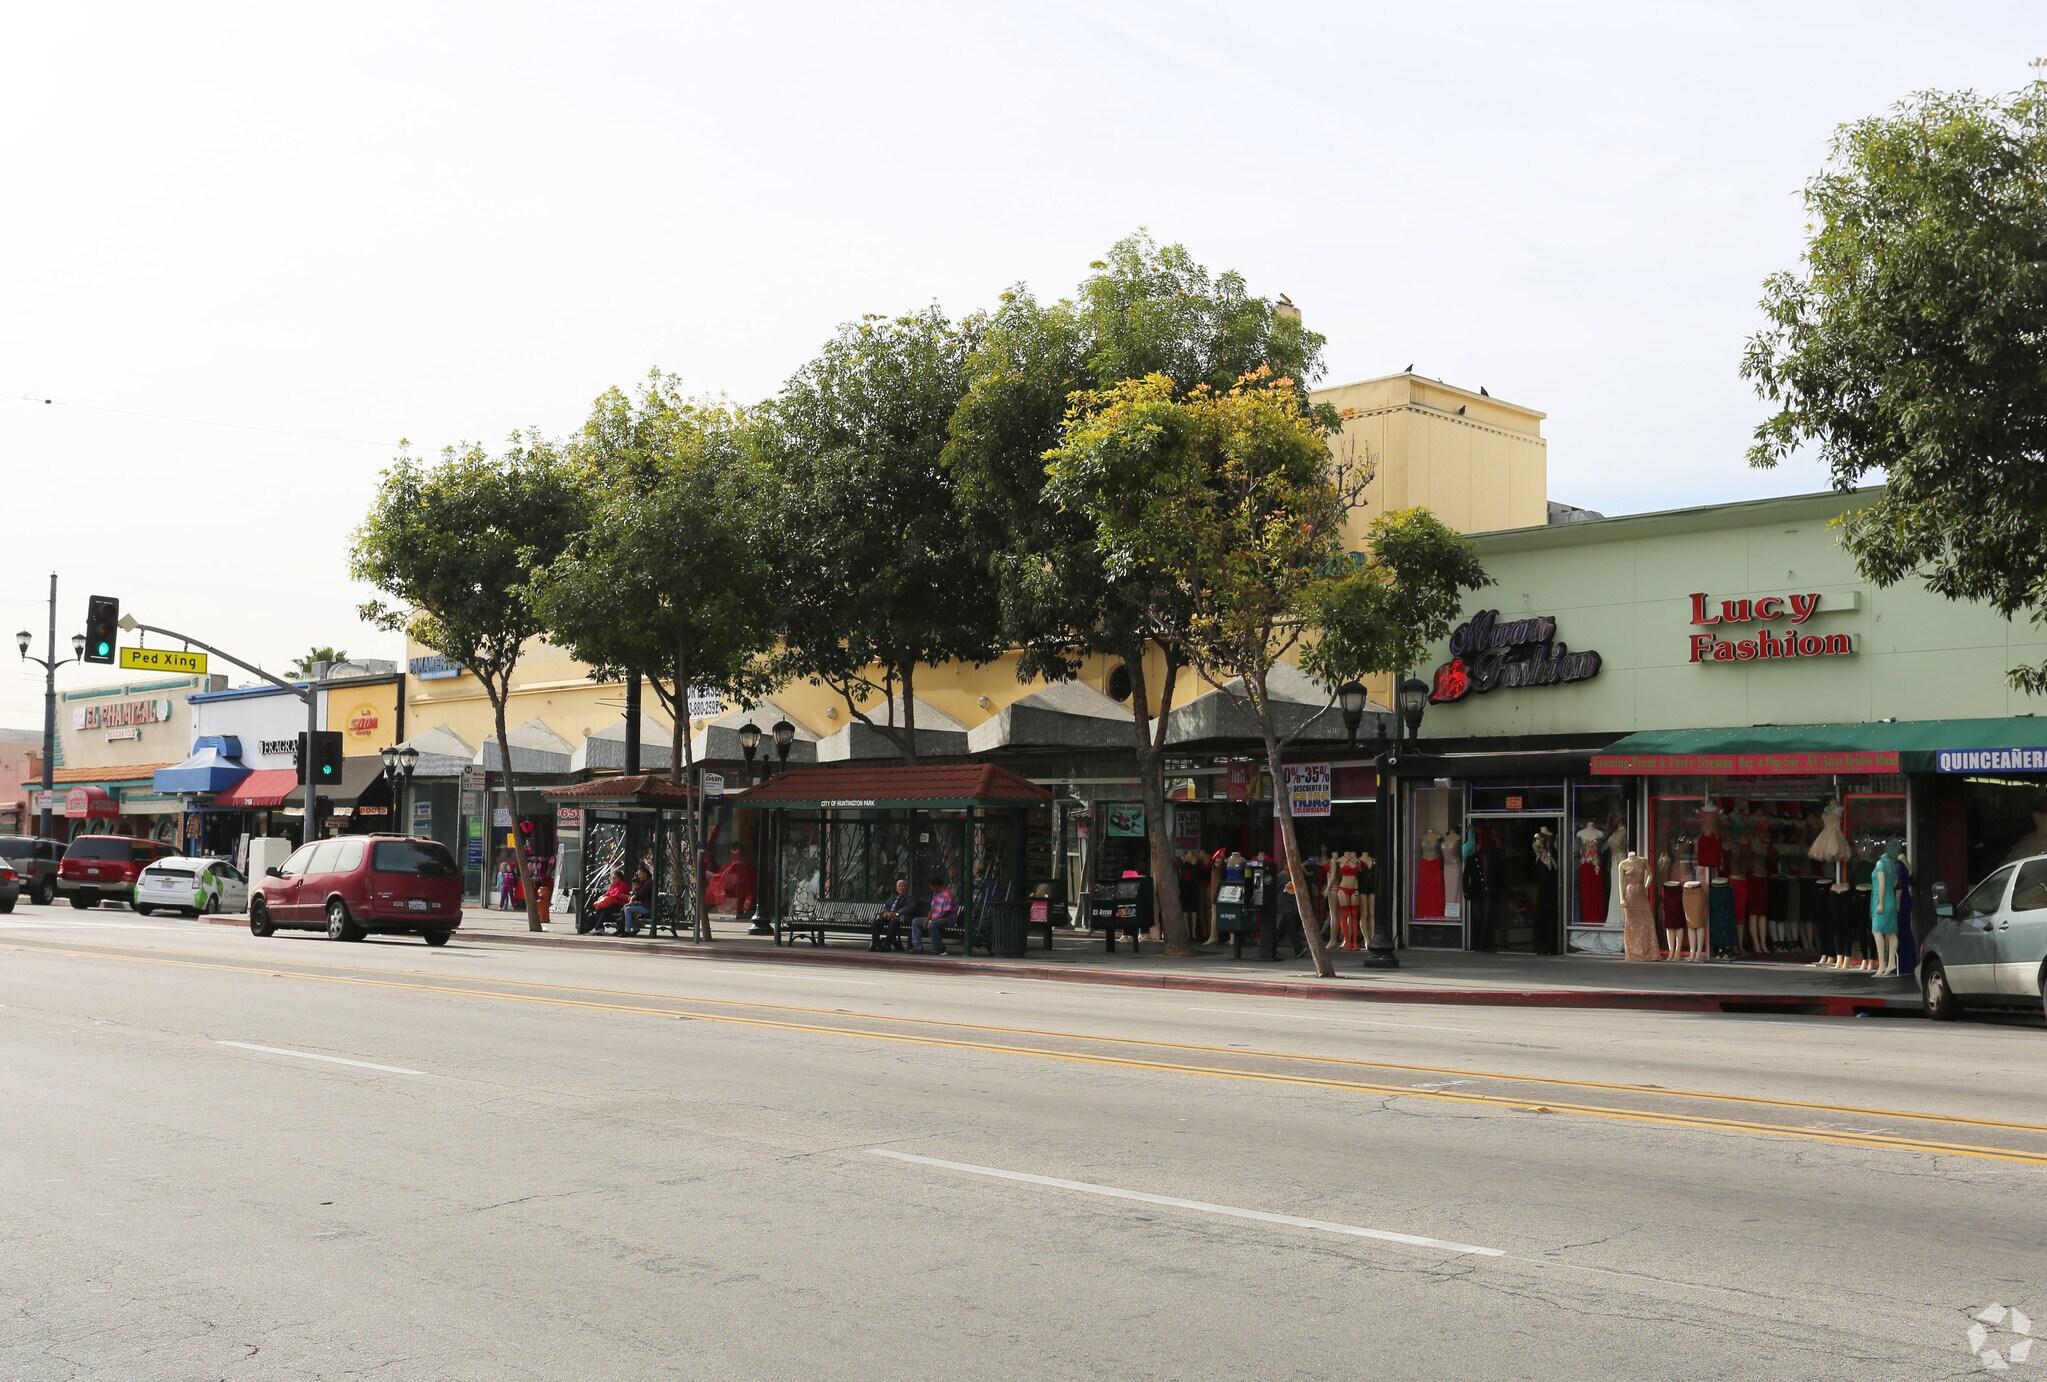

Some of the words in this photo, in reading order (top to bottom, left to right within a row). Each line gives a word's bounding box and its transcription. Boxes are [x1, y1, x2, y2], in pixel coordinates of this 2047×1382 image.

[1689, 592, 1819, 625] Lucy
[1689, 629, 1851, 663] Fashion
[132, 651, 158, 664] Ped
[164, 654, 196, 669] Xing
[1475, 645, 1600, 690] Fashion
[86, 706, 100, 728] EL
[1593, 756, 1630, 769] Evening
[1632, 756, 1657, 768] Prom
[1669, 756, 1696, 769] Party
[1698, 755, 1734, 768] Dresses
[1284, 766, 1330, 784] 0%-35%
[1293, 784, 1322, 792] DESCUENTO
[1323, 783, 1330, 791] EN
[1293, 791, 1330, 807] FAJAS
[360, 806, 388, 815] BOOTS
